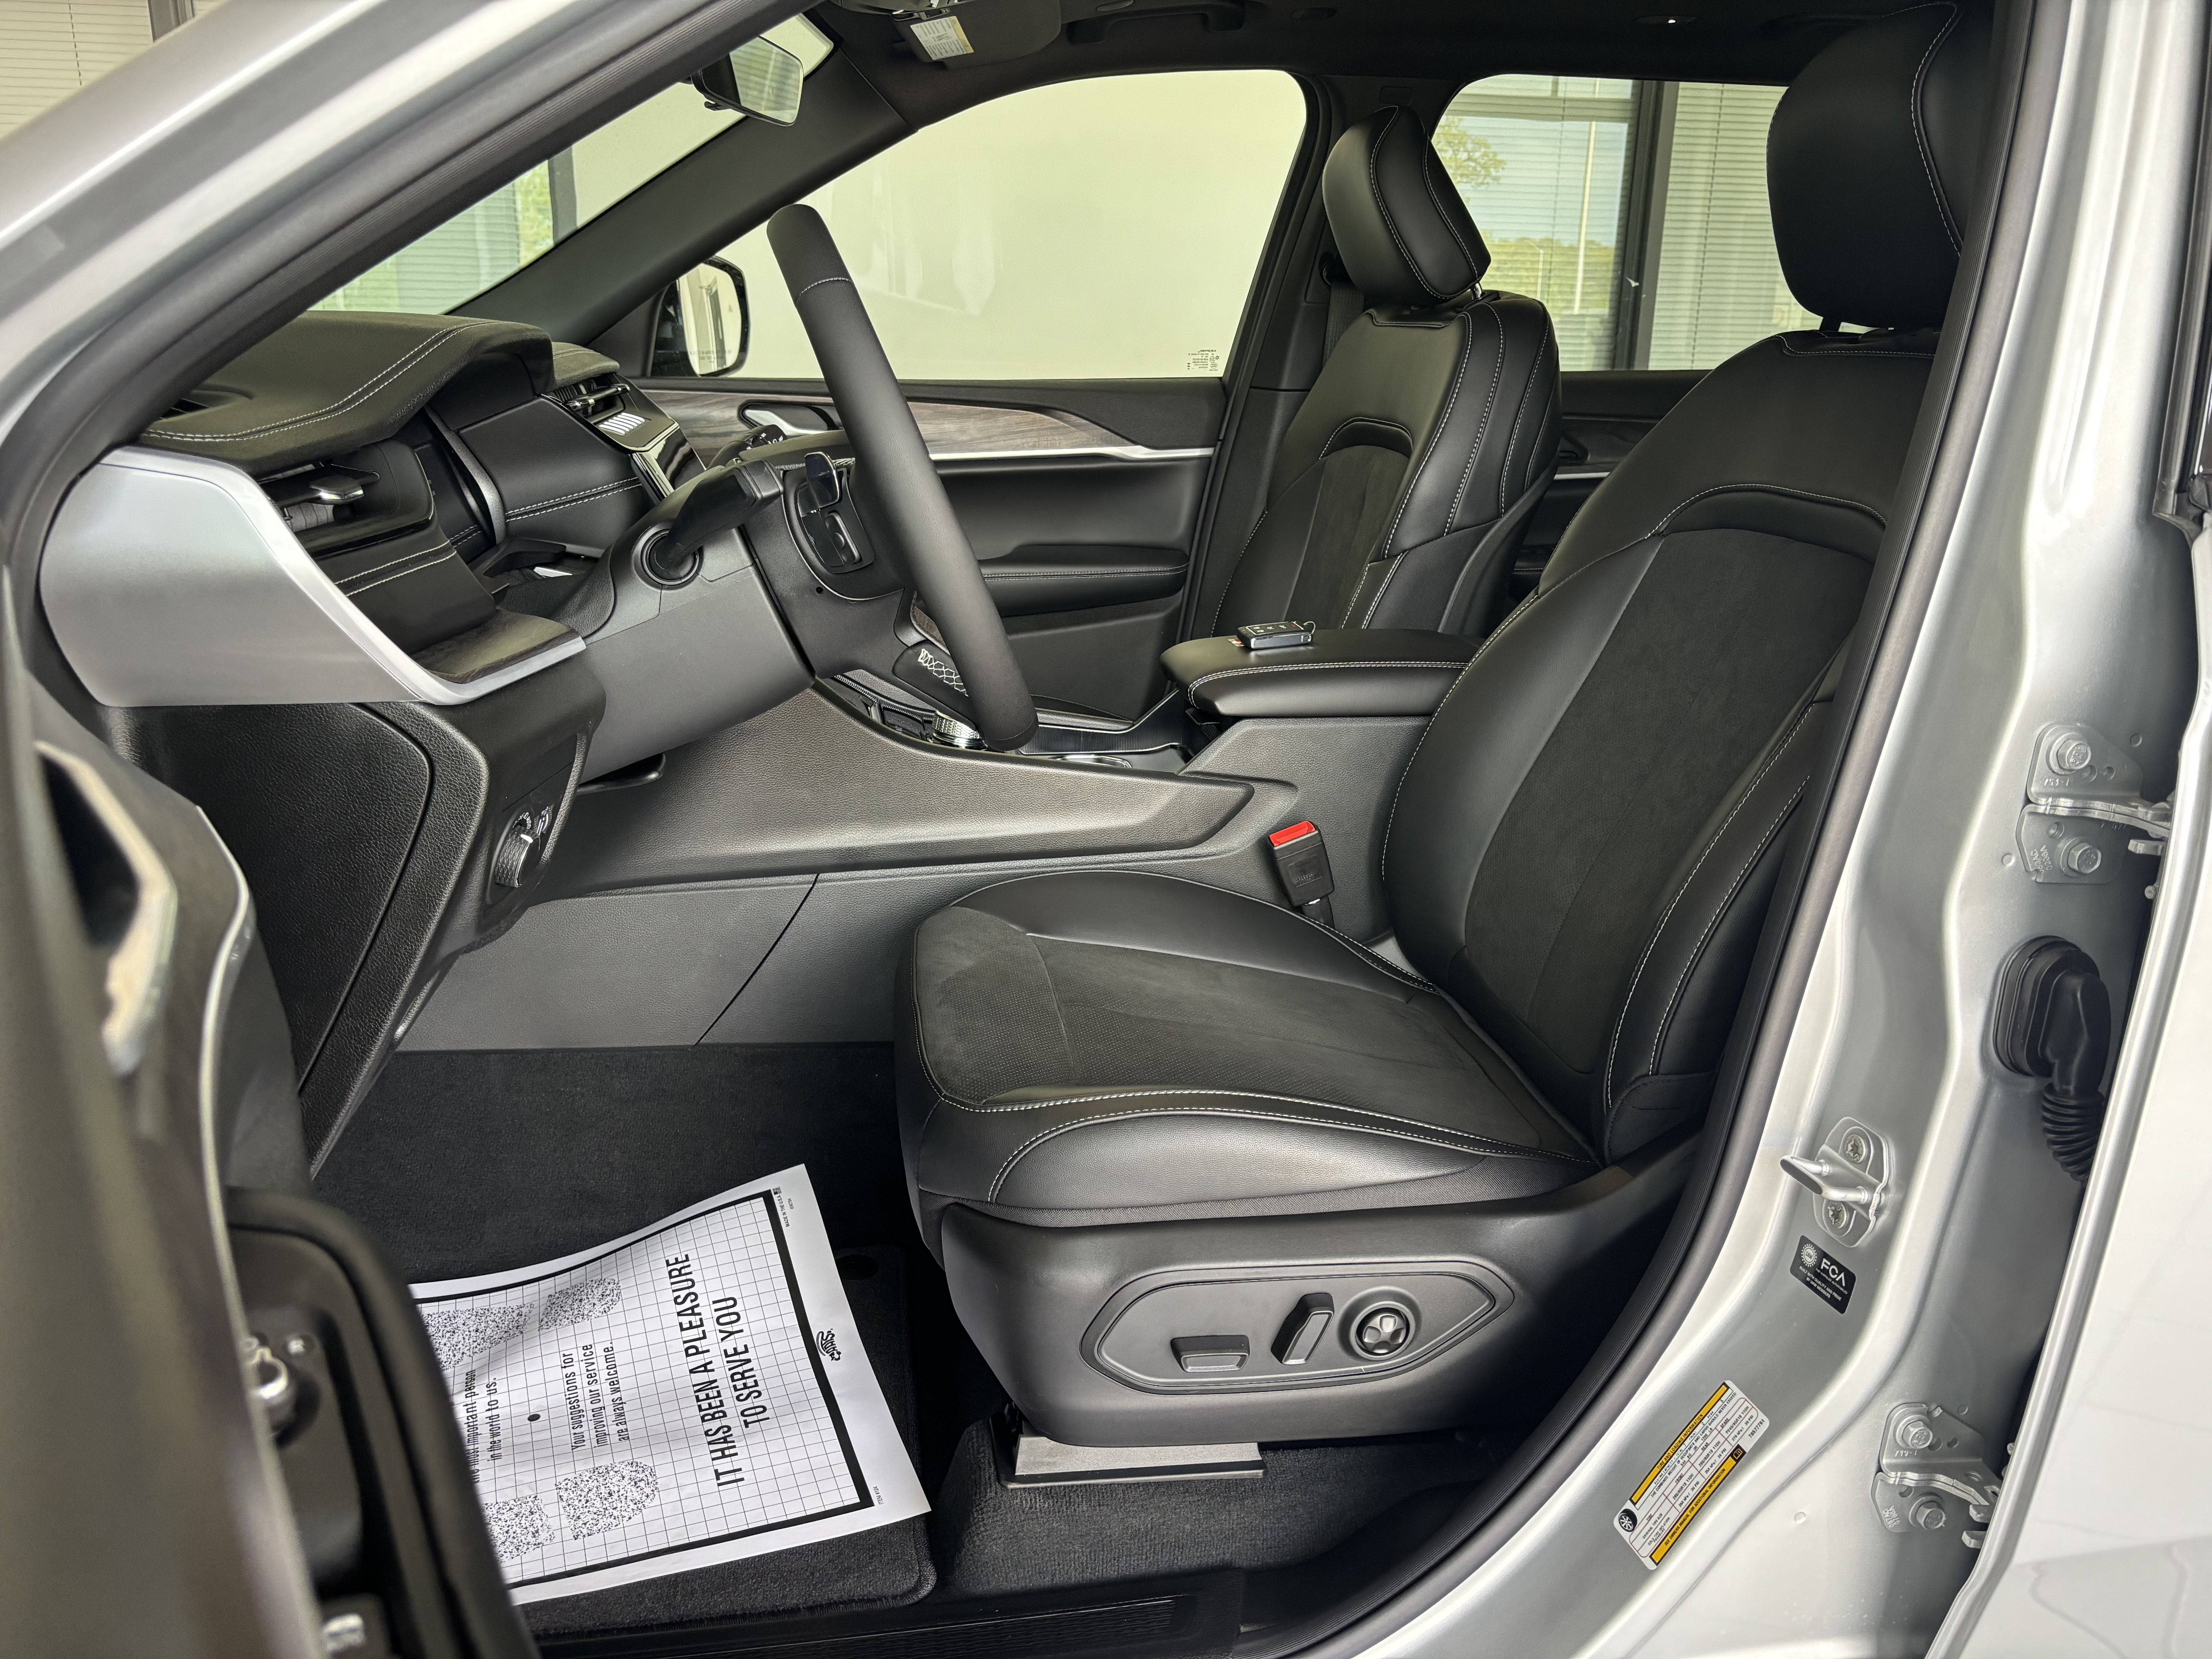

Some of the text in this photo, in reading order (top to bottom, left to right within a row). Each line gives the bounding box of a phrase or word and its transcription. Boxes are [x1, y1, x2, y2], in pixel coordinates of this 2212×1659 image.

[1814, 1277, 1826, 1289] QUALITY
[465, 1369, 479, 1398] person
[561, 1353, 586, 1450] Your suggestions for
[580, 1344, 610, 1448] improving our service
[603, 1341, 630, 1441] are always welcome.
[666, 1254, 745, 1487] IT HAS BEEN A PLEASURE
[712, 1297, 770, 1429] TO SERVE YOU
[463, 1401, 482, 1446] important
[485, 1377, 502, 1462] in the world to us.
[1655, 1475, 1669, 1492] COMBINED
[1668, 1464, 1678, 1476] WEIGHT
[1680, 1442, 1695, 1460] OCCUPANTS
[1700, 1425, 1709, 1436] CARGO
[1708, 1413, 1719, 1426] SHOULD
[1718, 1403, 1727, 1414] NEVER
[1726, 1392, 1736, 1404] EXCEED
[1657, 1413, 1703, 1470] TIRE AND LOADING INFORMATION
[1674, 1473, 1684, 1484] FRONT
[1701, 1442, 1709, 1451] REAR
[1720, 1417, 1729, 1429] SPARE
[1642, 1525, 1653, 1539] ORIGINAL
[1712, 1440, 1721, 1450] 110H
[1741, 1405, 1749, 1415] 110H
[1678, 1513, 1690, 1527] MANUAL
[1694, 1489, 1709, 1507] ADDITIONAL
[1708, 1468, 1726, 1489] INFORMATION
